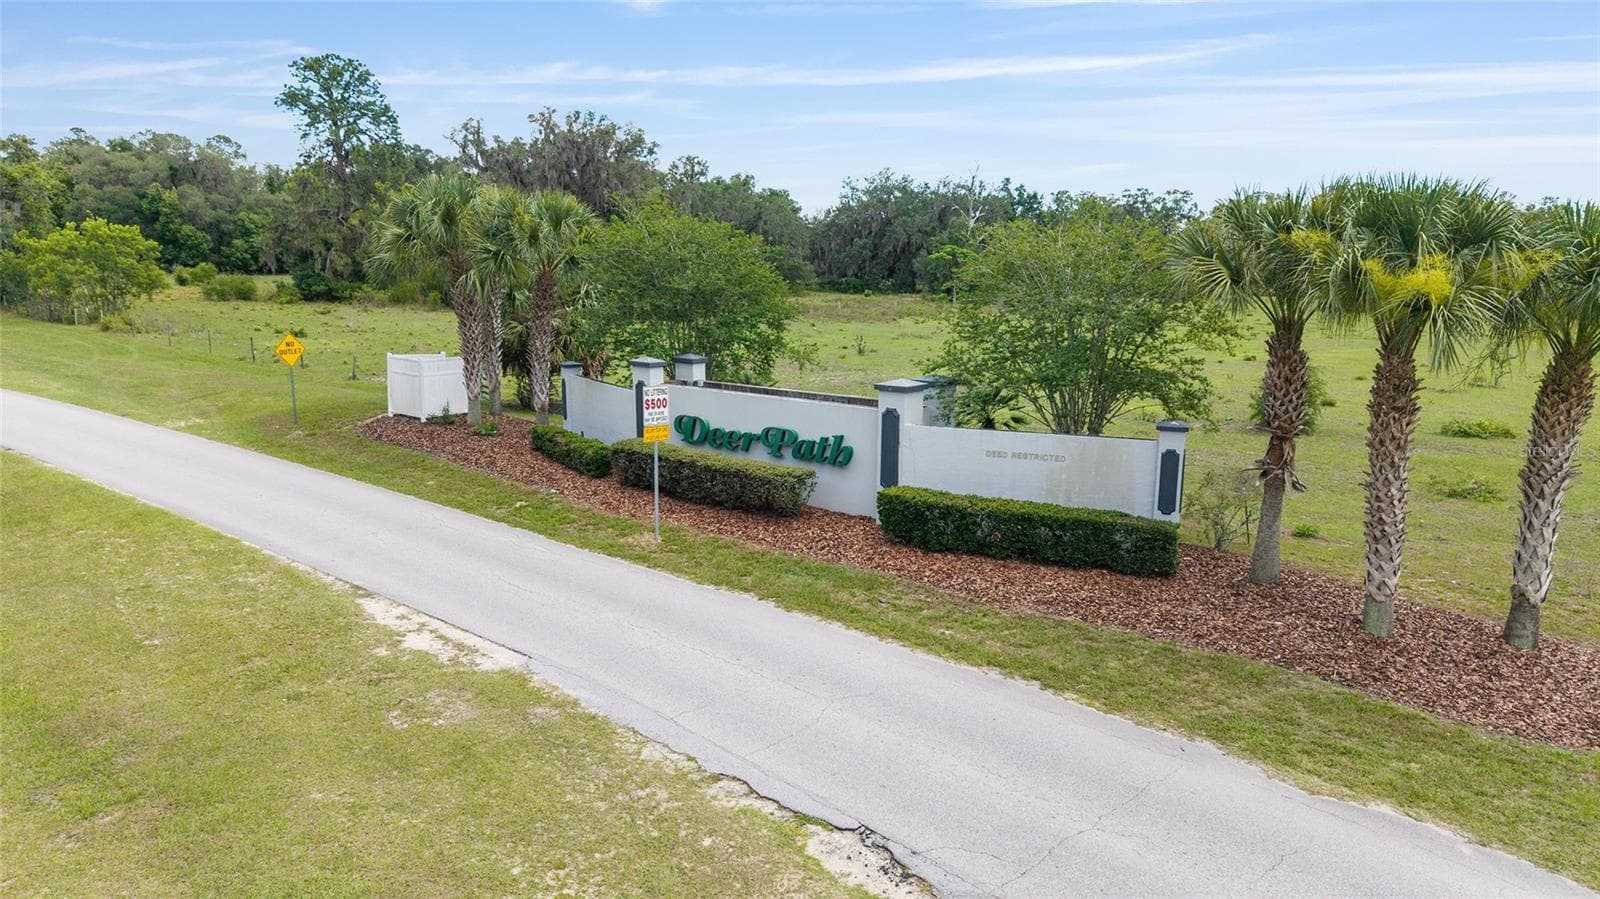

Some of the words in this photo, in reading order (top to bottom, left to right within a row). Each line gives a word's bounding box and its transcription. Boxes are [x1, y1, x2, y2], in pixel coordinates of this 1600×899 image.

[645, 397, 667, 411] $500
[673, 414, 759, 453] Deer
[759, 426, 854, 468] Path
[985, 450, 1008, 459] DEED
[1010, 451, 1066, 463] RESTRICTED
